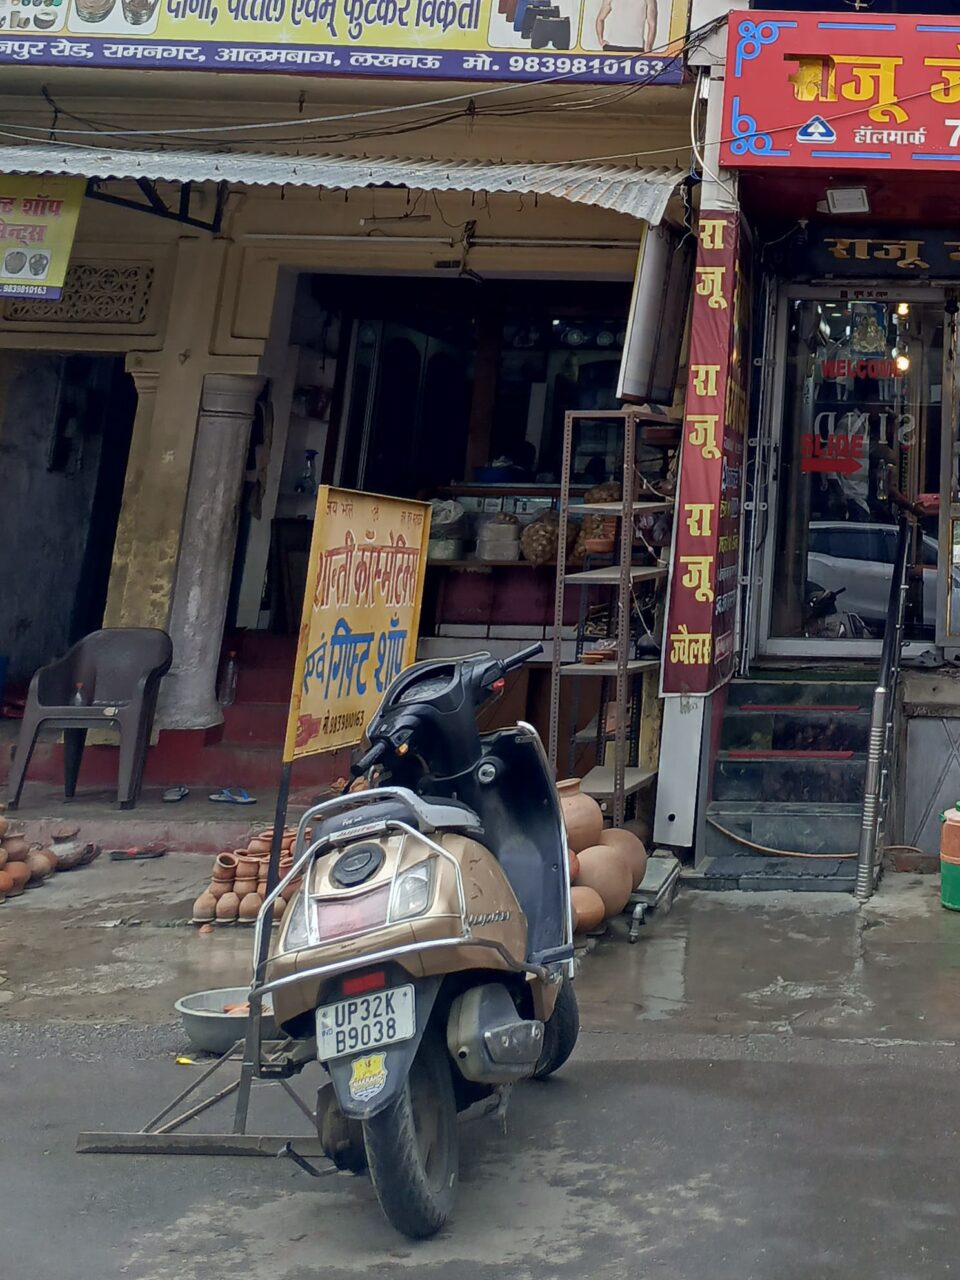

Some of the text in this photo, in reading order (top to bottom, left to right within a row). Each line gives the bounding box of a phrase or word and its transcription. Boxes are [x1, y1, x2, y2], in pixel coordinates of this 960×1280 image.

[0, 39, 662, 76] नपुर रोड, रामनगर, आलमबाग, लखनऊ मो. 9839810163
[854, 126, 927, 145] हॉलमार्क
[823, 238, 930, 268] राजू
[821, 358, 905, 379] WELCOM
[801, 433, 864, 457] SLIDE
[324, 618, 375, 699] गिफ्ट
[334, 991, 396, 1028] UP32K
[335, 1017, 397, 1054] B9038
